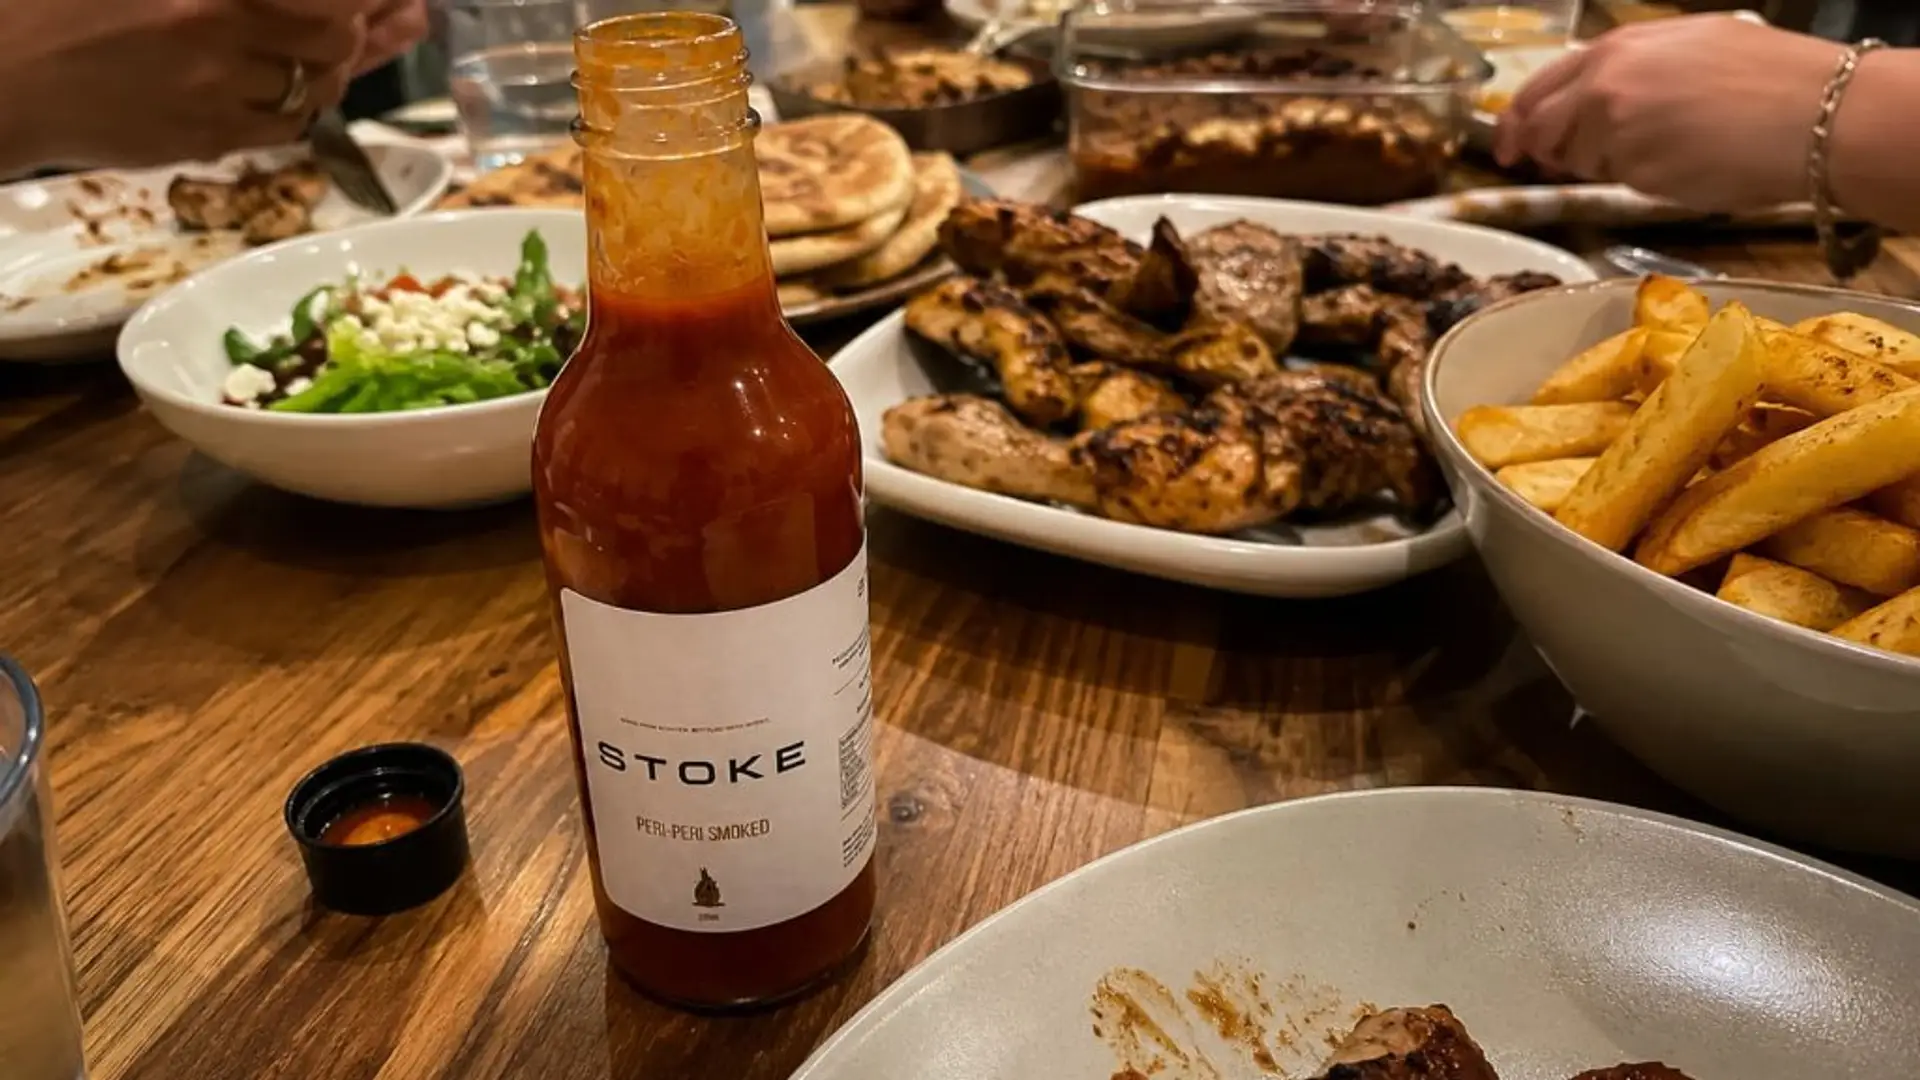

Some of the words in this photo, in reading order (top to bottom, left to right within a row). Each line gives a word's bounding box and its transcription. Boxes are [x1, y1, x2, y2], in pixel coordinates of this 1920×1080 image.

[598, 740, 806, 785] STOKE
[636, 815, 704, 841] PERI-PERI
[708, 818, 770, 841] SMOKED
